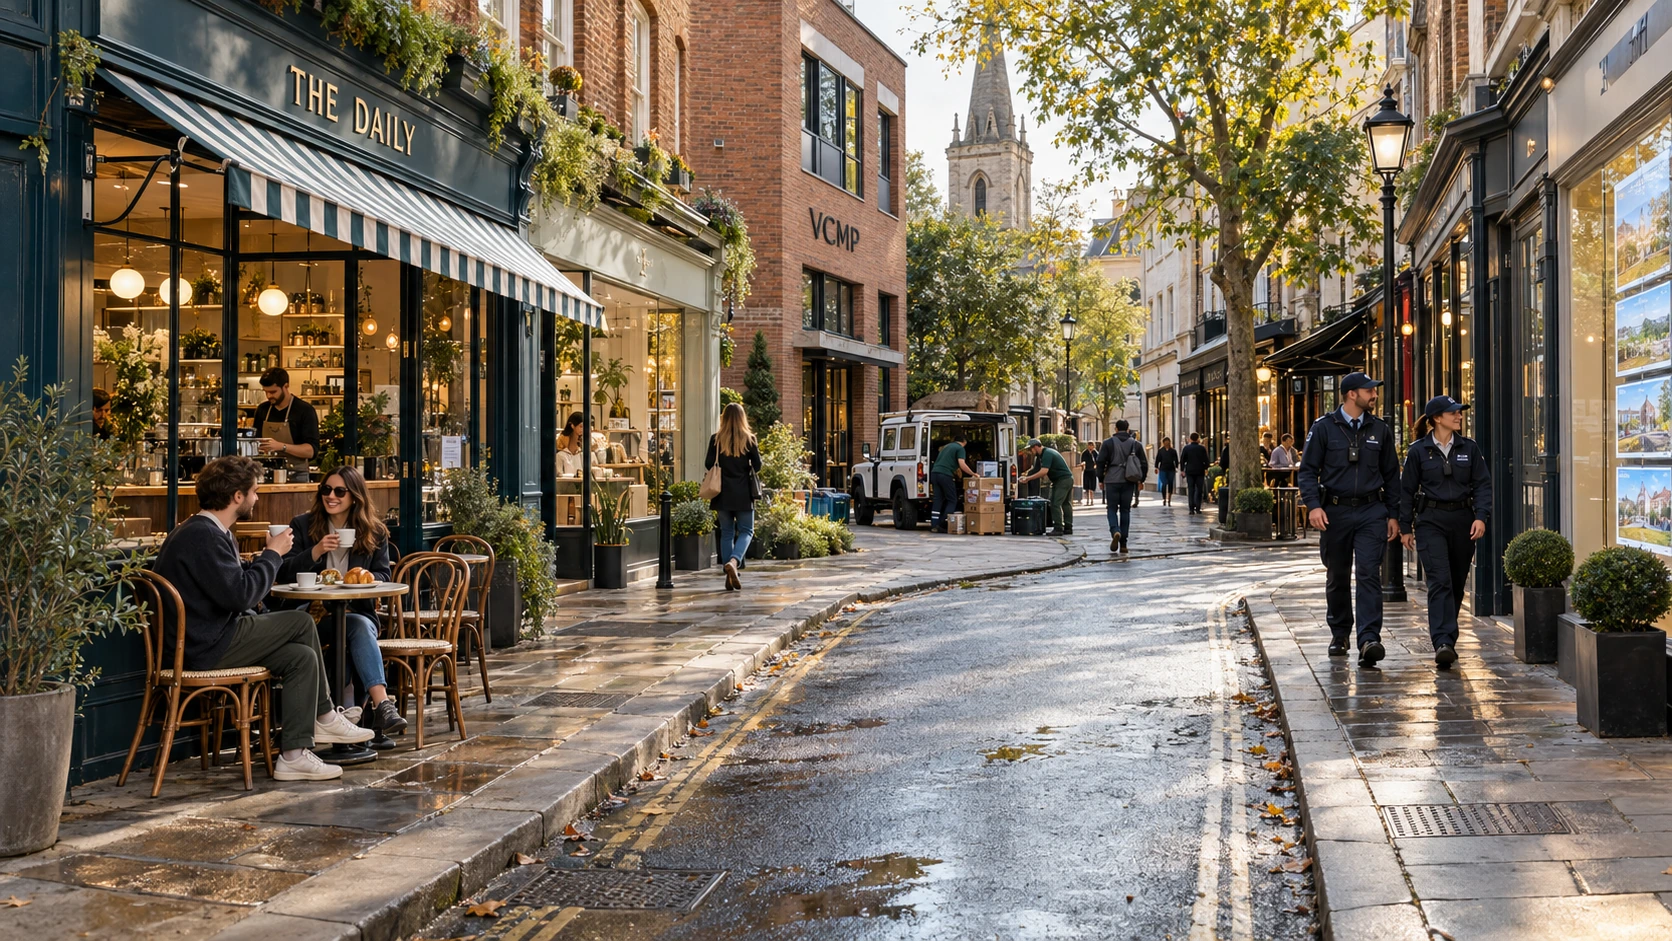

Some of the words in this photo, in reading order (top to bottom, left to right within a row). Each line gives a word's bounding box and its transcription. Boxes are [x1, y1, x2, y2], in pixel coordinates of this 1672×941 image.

[290, 65, 339, 123] THE
[355, 96, 416, 156] DAILY
[809, 207, 860, 252] VCMP
